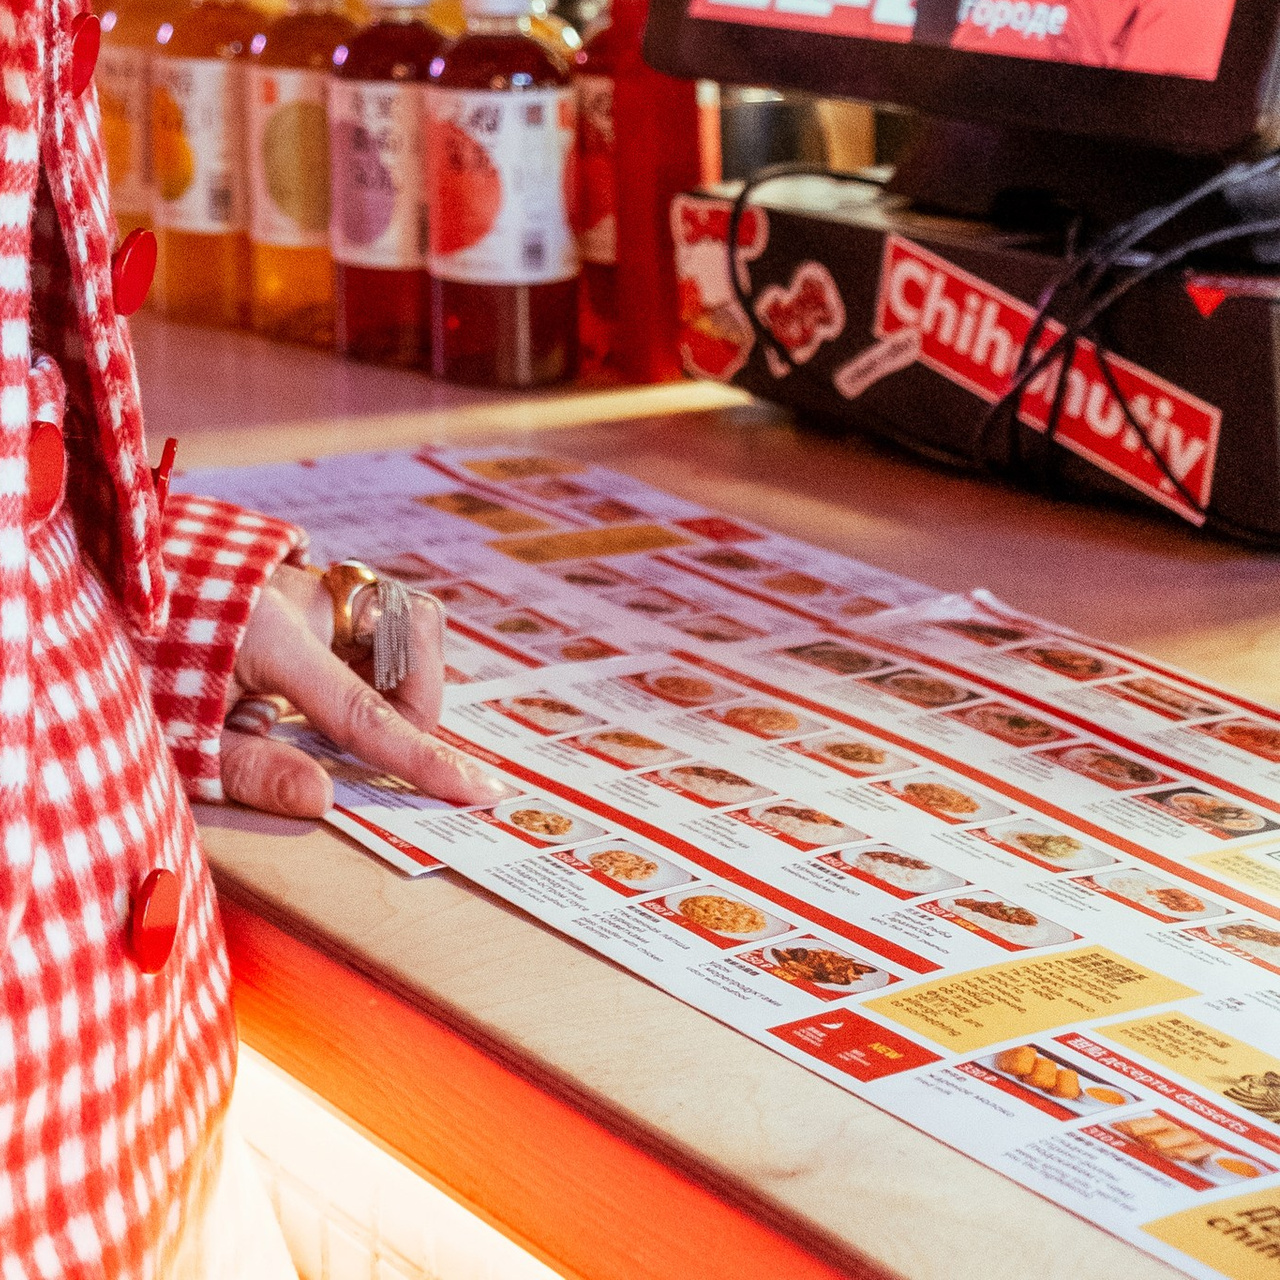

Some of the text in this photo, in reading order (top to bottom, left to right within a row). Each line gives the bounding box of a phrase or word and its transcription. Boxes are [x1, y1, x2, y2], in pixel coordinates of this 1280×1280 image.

[868, 1042, 904, 1060] NEW
[1101, 1055, 1175, 1094] десерты
[1177, 1092, 1249, 1133] desserts
